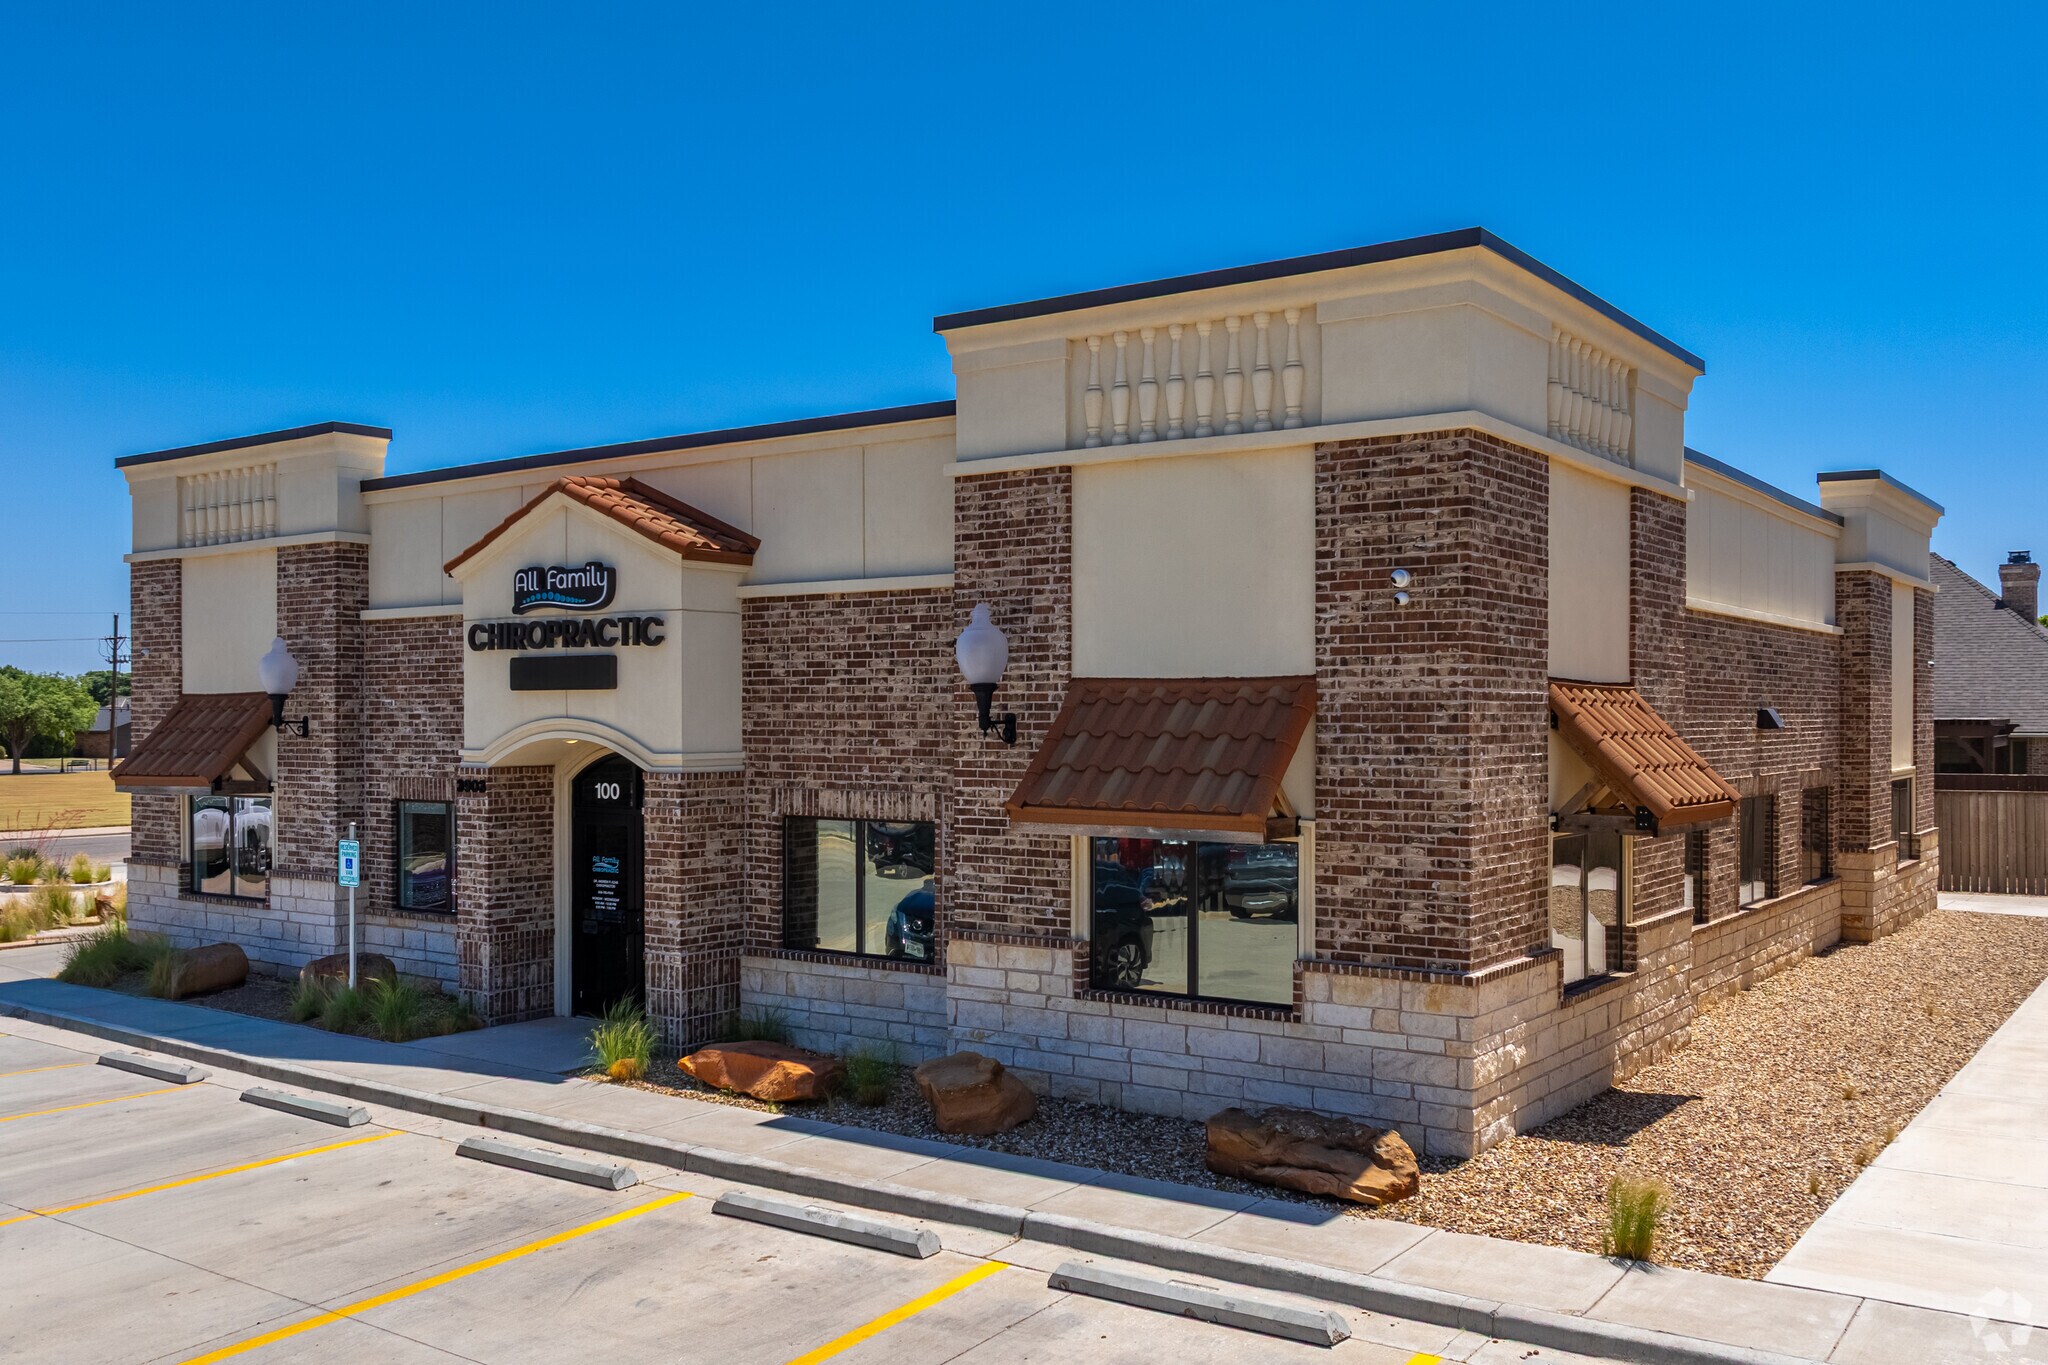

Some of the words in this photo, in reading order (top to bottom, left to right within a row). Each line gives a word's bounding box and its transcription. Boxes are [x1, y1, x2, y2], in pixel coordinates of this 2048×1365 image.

[515, 570, 540, 592] All
[547, 565, 608, 595] Family
[468, 616, 665, 651] CHIROPRACTIC
[594, 782, 620, 800] 100
